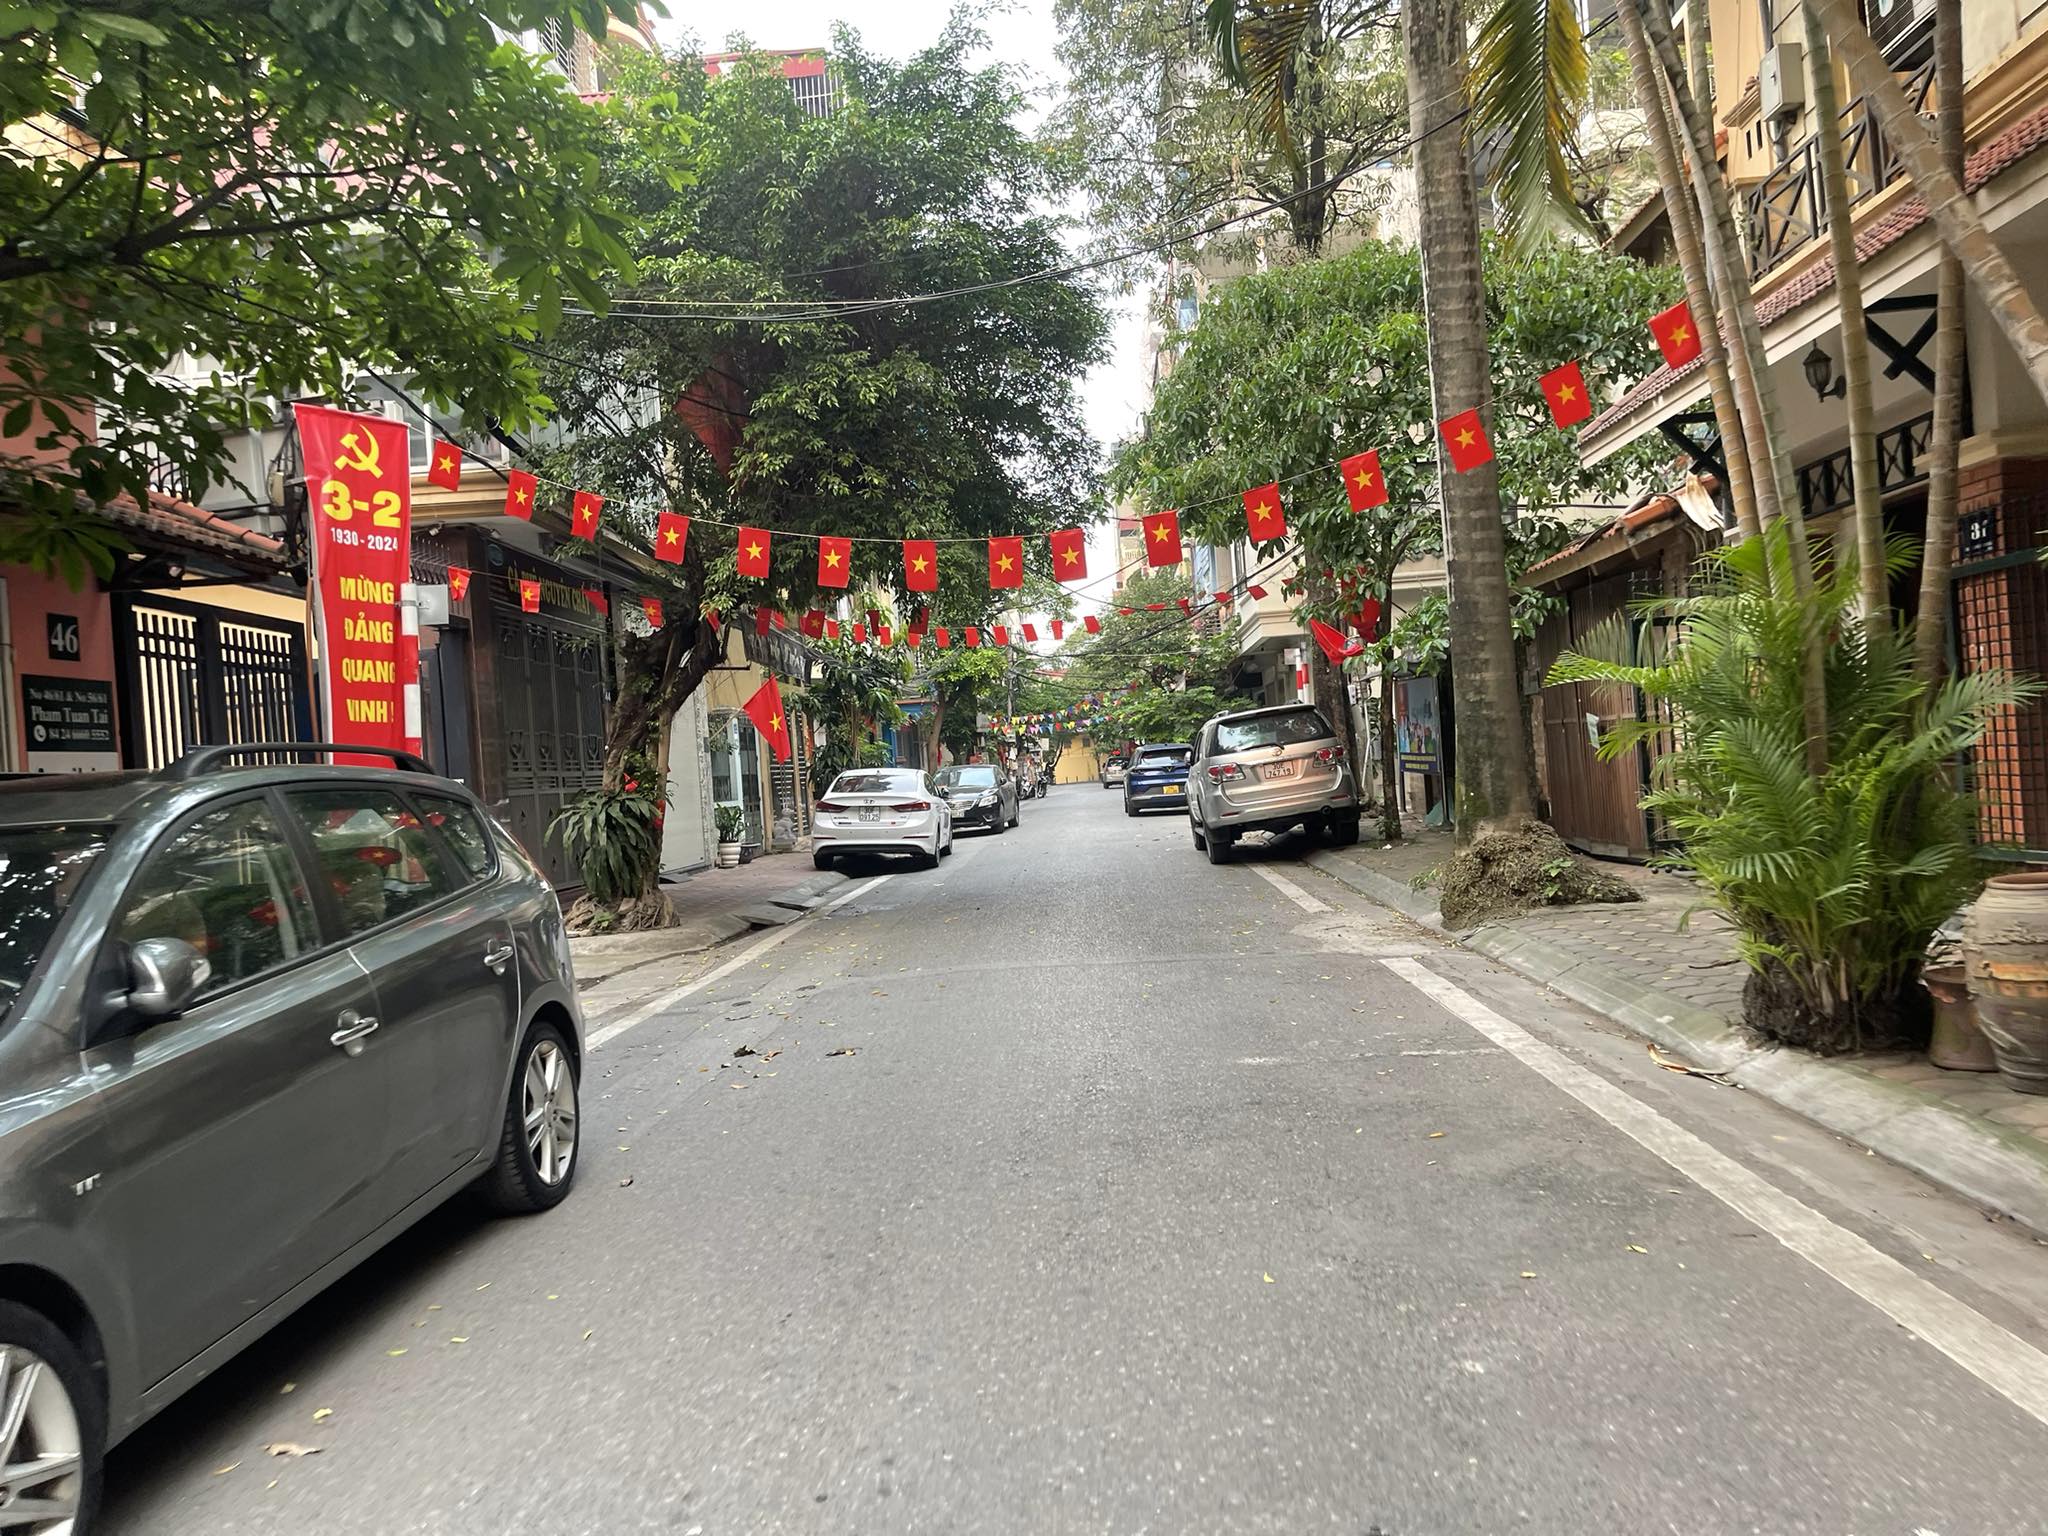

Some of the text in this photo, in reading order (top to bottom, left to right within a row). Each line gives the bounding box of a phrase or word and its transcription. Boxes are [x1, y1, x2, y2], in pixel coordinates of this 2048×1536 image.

[321, 480, 401, 528] 3-2
[330, 527, 359, 546] 1930
[367, 534, 399, 551] 2024
[339, 574, 395, 605] MỪNG
[51, 623, 78, 653] 46
[344, 612, 394, 644] ĐẢNG
[31, 705, 108, 724] Pham Tuan Tai
[346, 698, 388, 723] VINH
